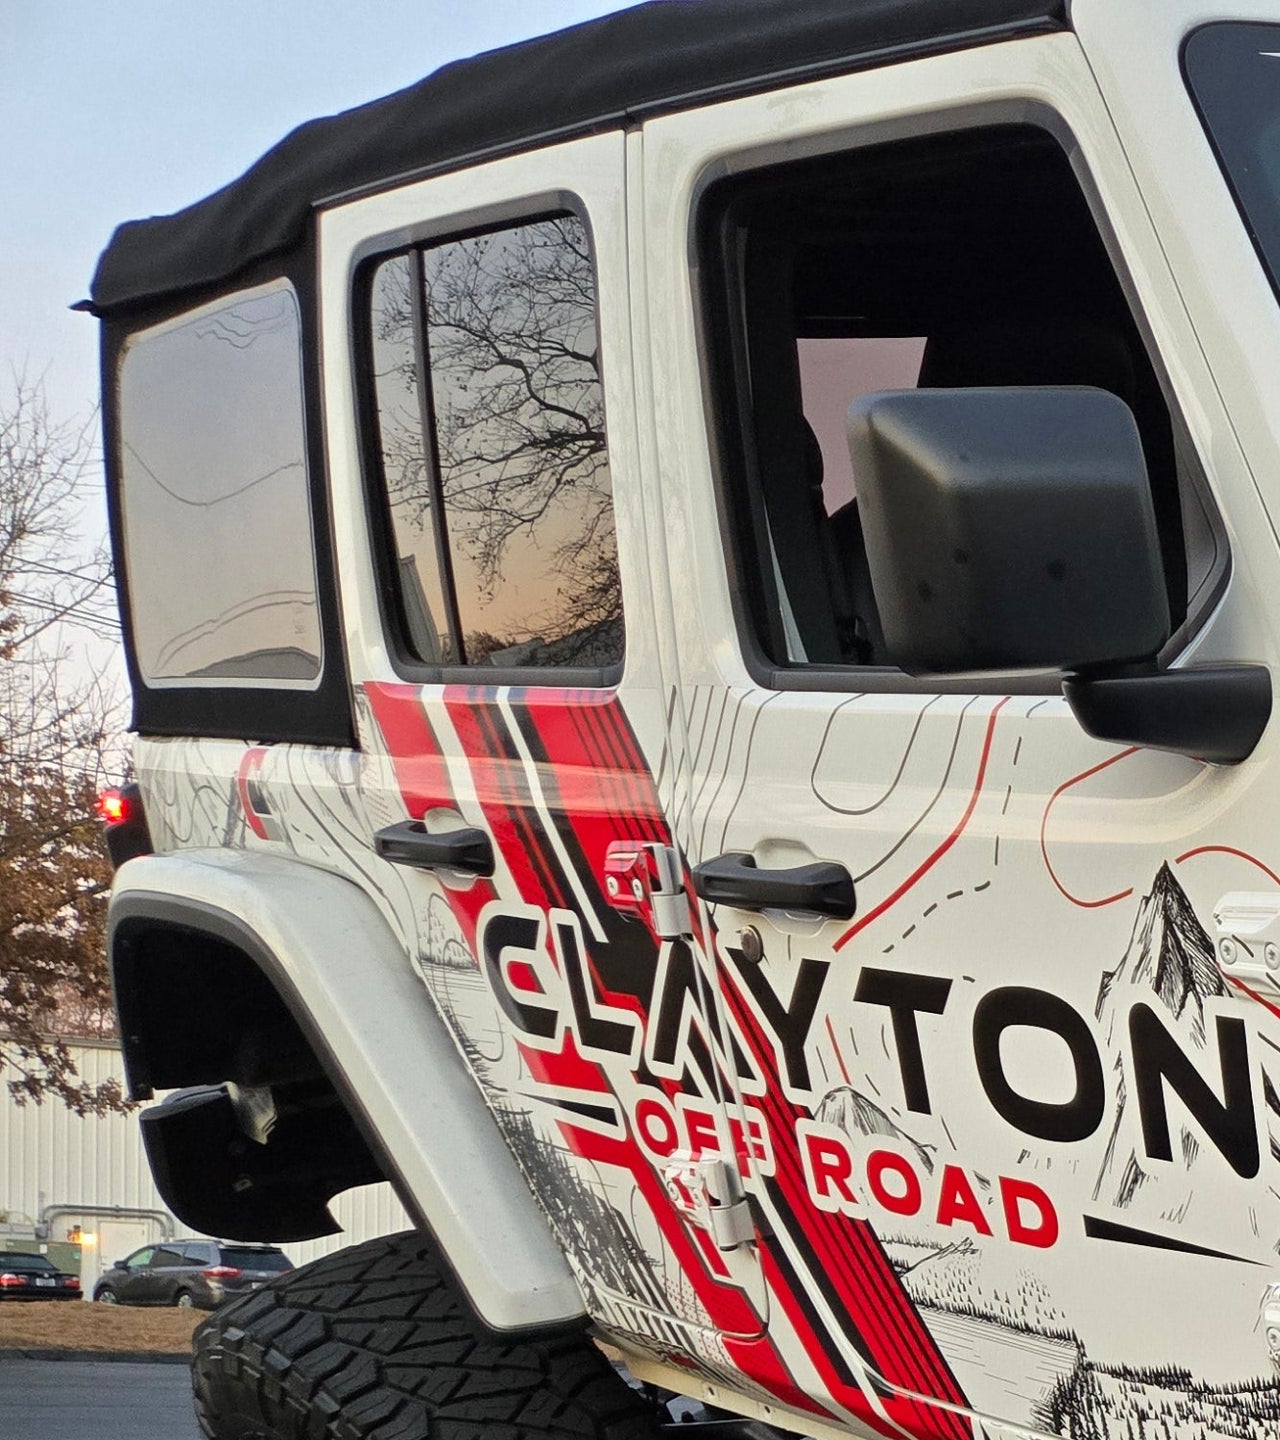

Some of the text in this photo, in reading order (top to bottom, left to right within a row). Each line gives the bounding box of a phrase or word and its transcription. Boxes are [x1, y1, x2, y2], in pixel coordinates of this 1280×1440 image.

[482, 912, 1262, 1180] CLAYTON
[635, 1096, 1060, 1250] OFF ROAD
